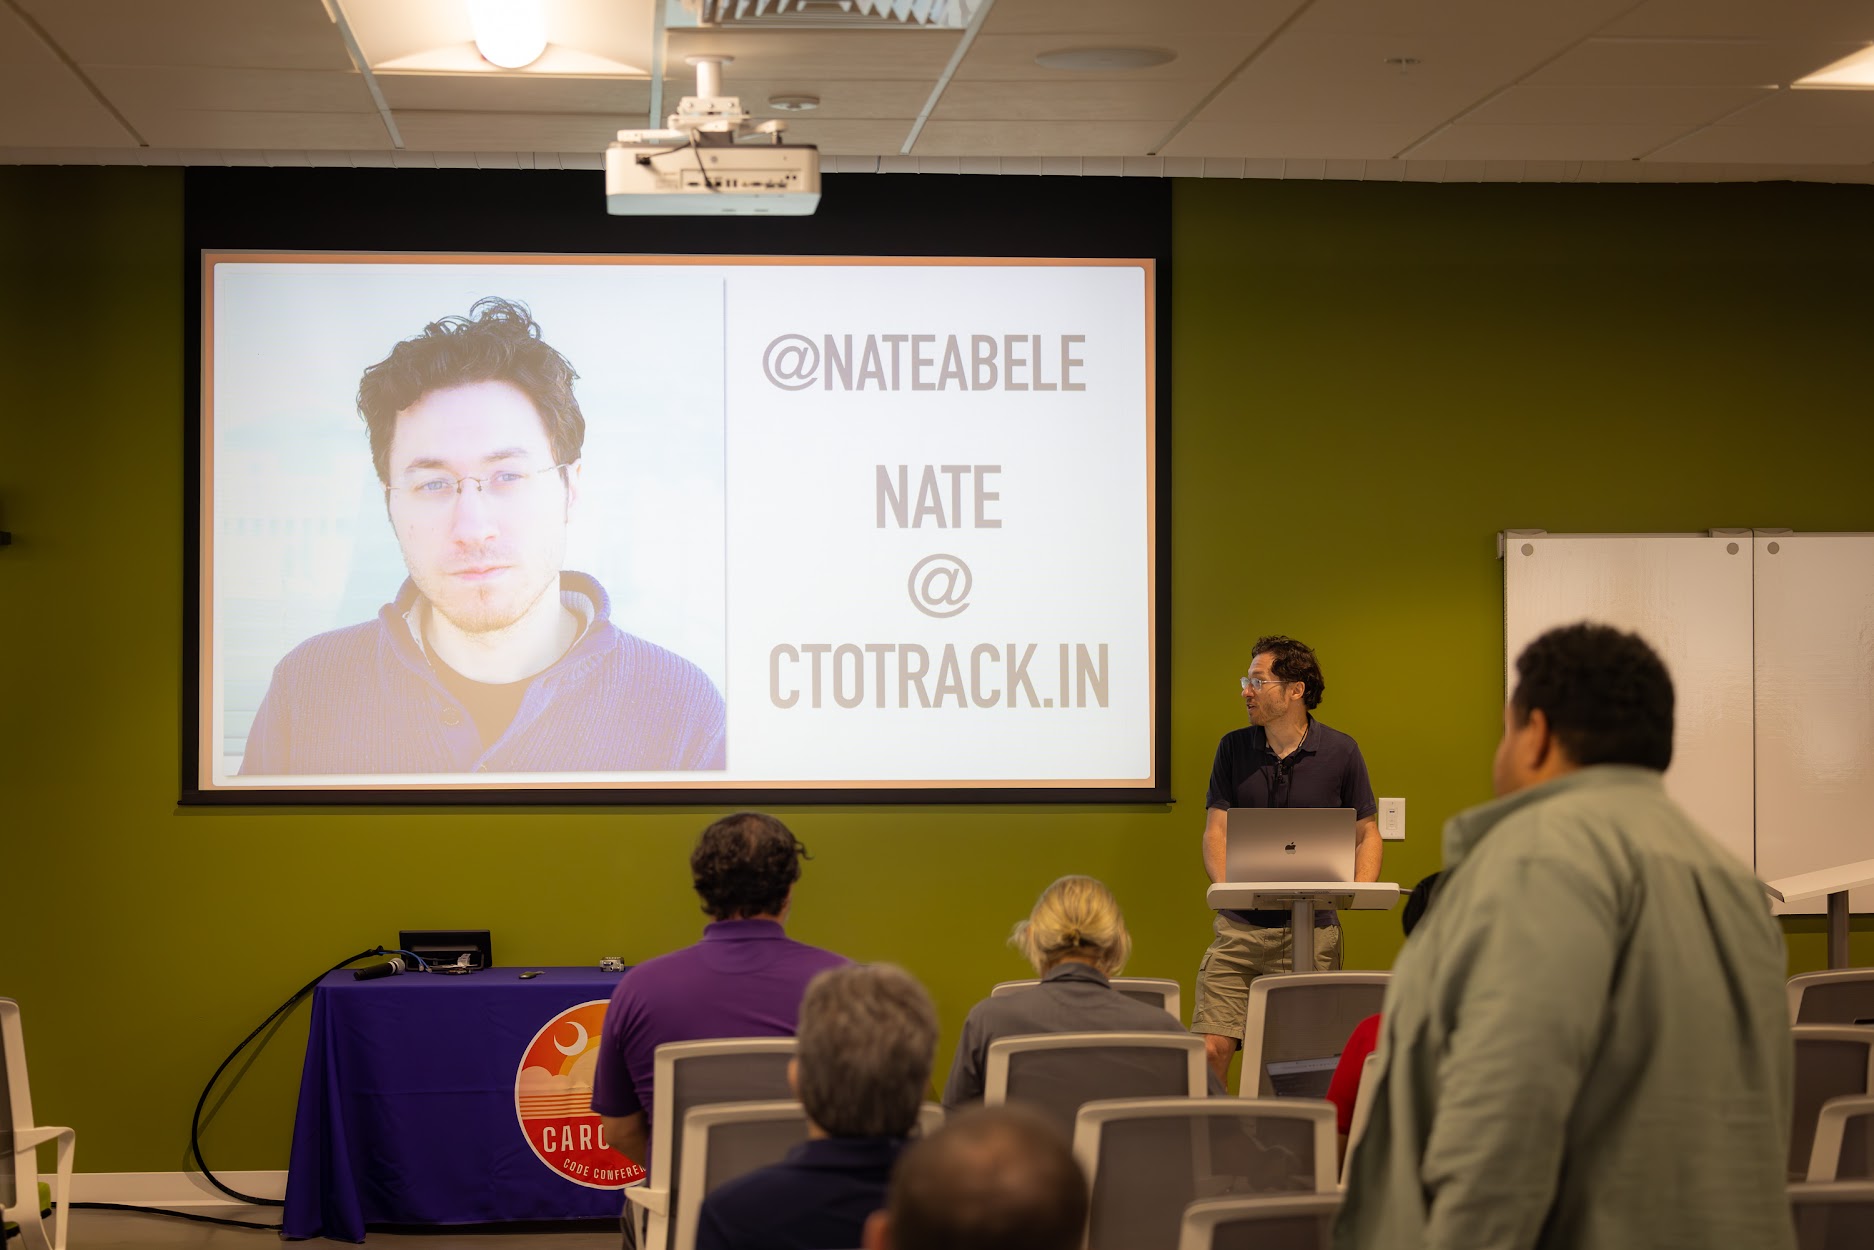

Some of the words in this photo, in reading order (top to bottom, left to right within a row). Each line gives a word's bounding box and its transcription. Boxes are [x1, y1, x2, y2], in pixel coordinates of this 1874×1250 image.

[762, 333, 1087, 391] @NATEABELE
[876, 464, 1002, 529] NATE
[908, 553, 973, 619] @
[769, 643, 1109, 709] CTOTRACK.IN
[563, 1158, 589, 1177] CODE
